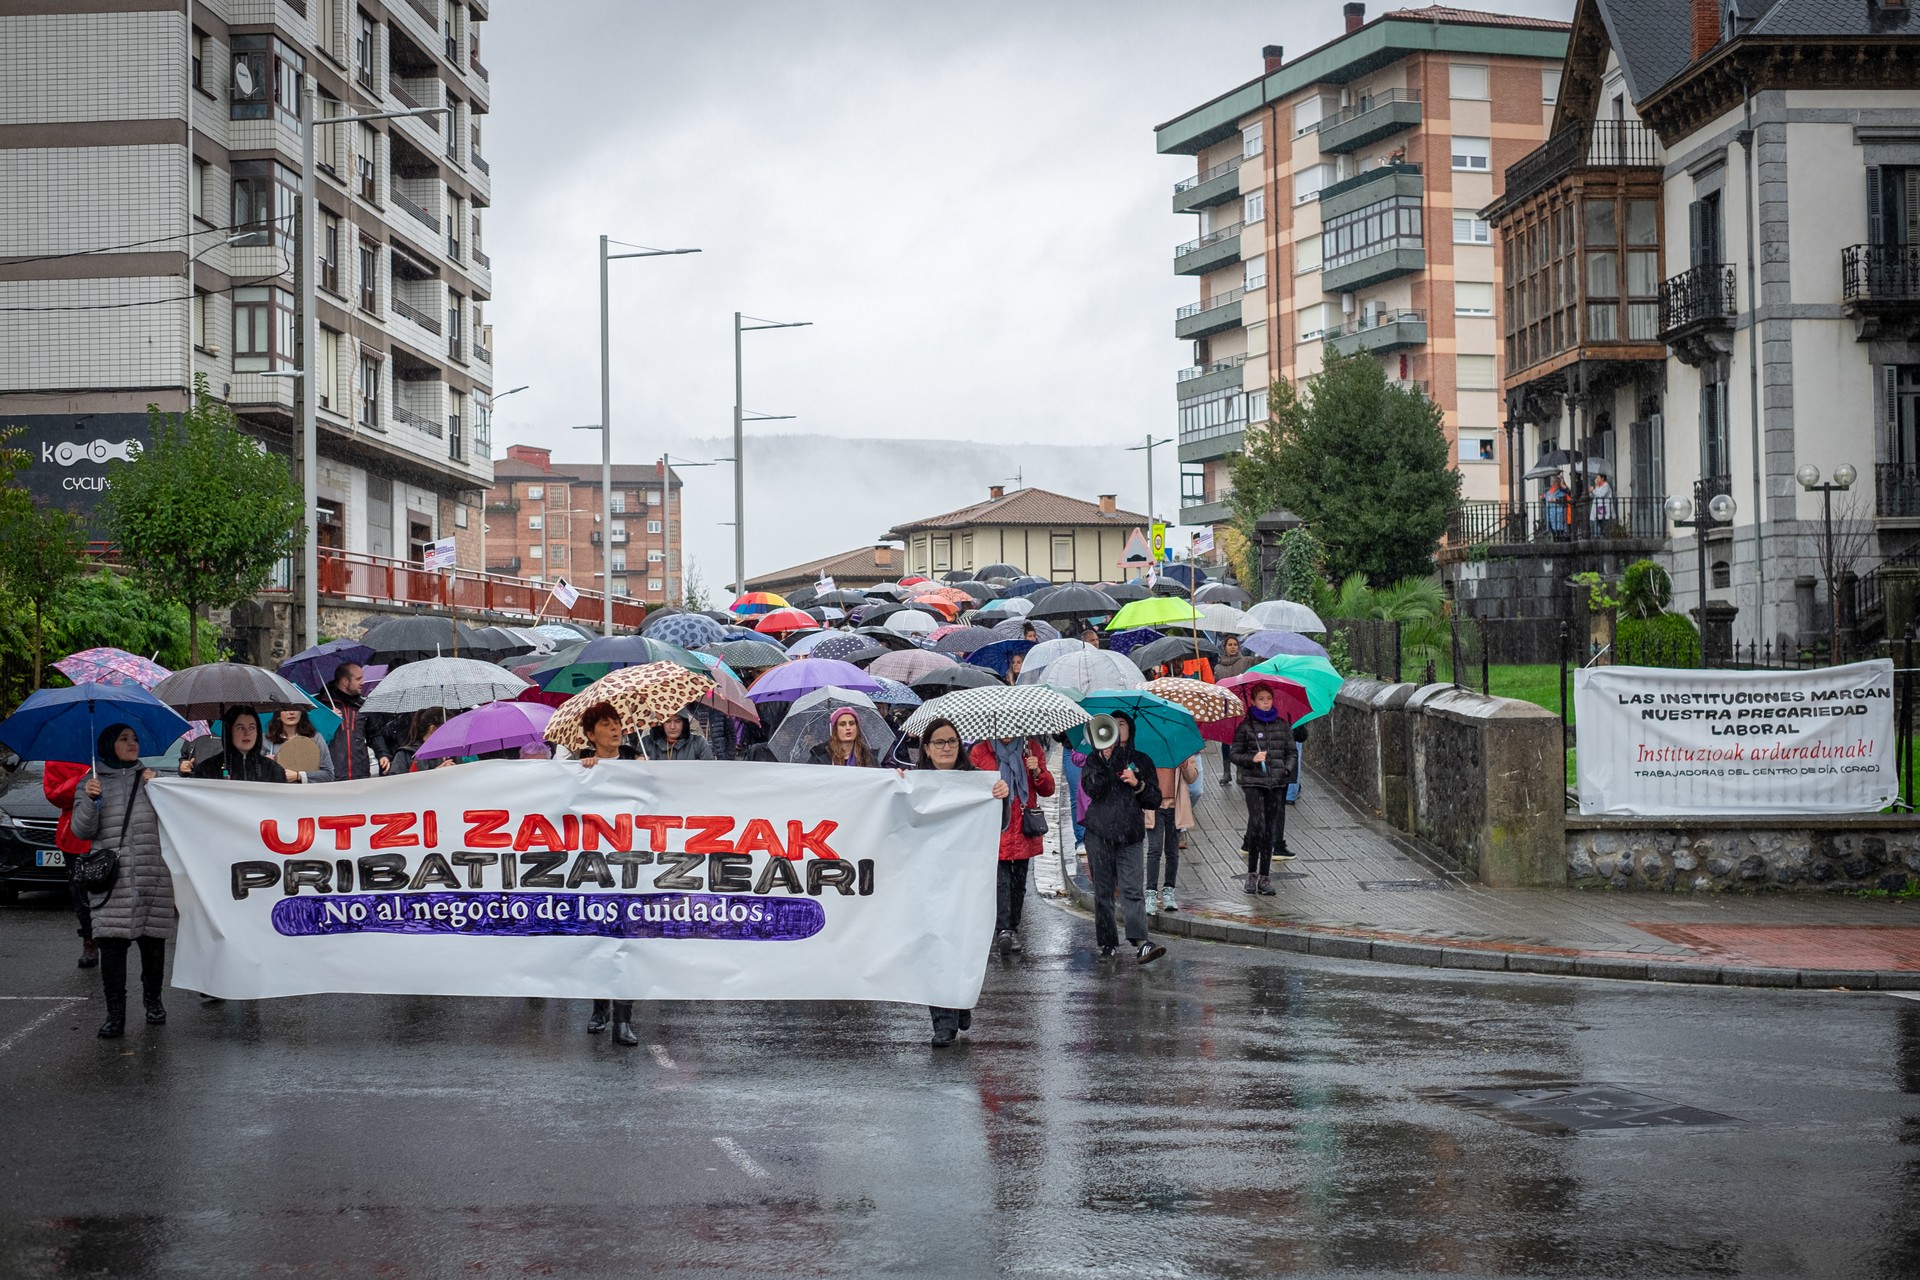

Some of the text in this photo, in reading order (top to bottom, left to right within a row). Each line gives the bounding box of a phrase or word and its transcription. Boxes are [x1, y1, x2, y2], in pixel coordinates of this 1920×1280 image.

[62, 477, 120, 491] CYCLIN
[1618, 688, 1891, 705] LAS INSTITUCIONES MARCAN
[1641, 709, 1732, 721] NUESTRA
[1711, 724, 1800, 736] LABORAL
[1637, 738, 1873, 763] Instituzioak arduradunak!
[1634, 769, 1725, 778] TRABAJADORAS
[1728, 768, 1750, 776] DEL
[1752, 767, 1798, 776] CENTRO
[1800, 766, 1816, 774] DE
[1818, 764, 1838, 775] DÍA
[260, 810, 840, 861] UTZI ZAINTZAK
[45, 852, 65, 864] 79
[231, 851, 874, 900] PRIBATIZATZEARI
[324, 895, 773, 926] No al negocio de los cuidados.
